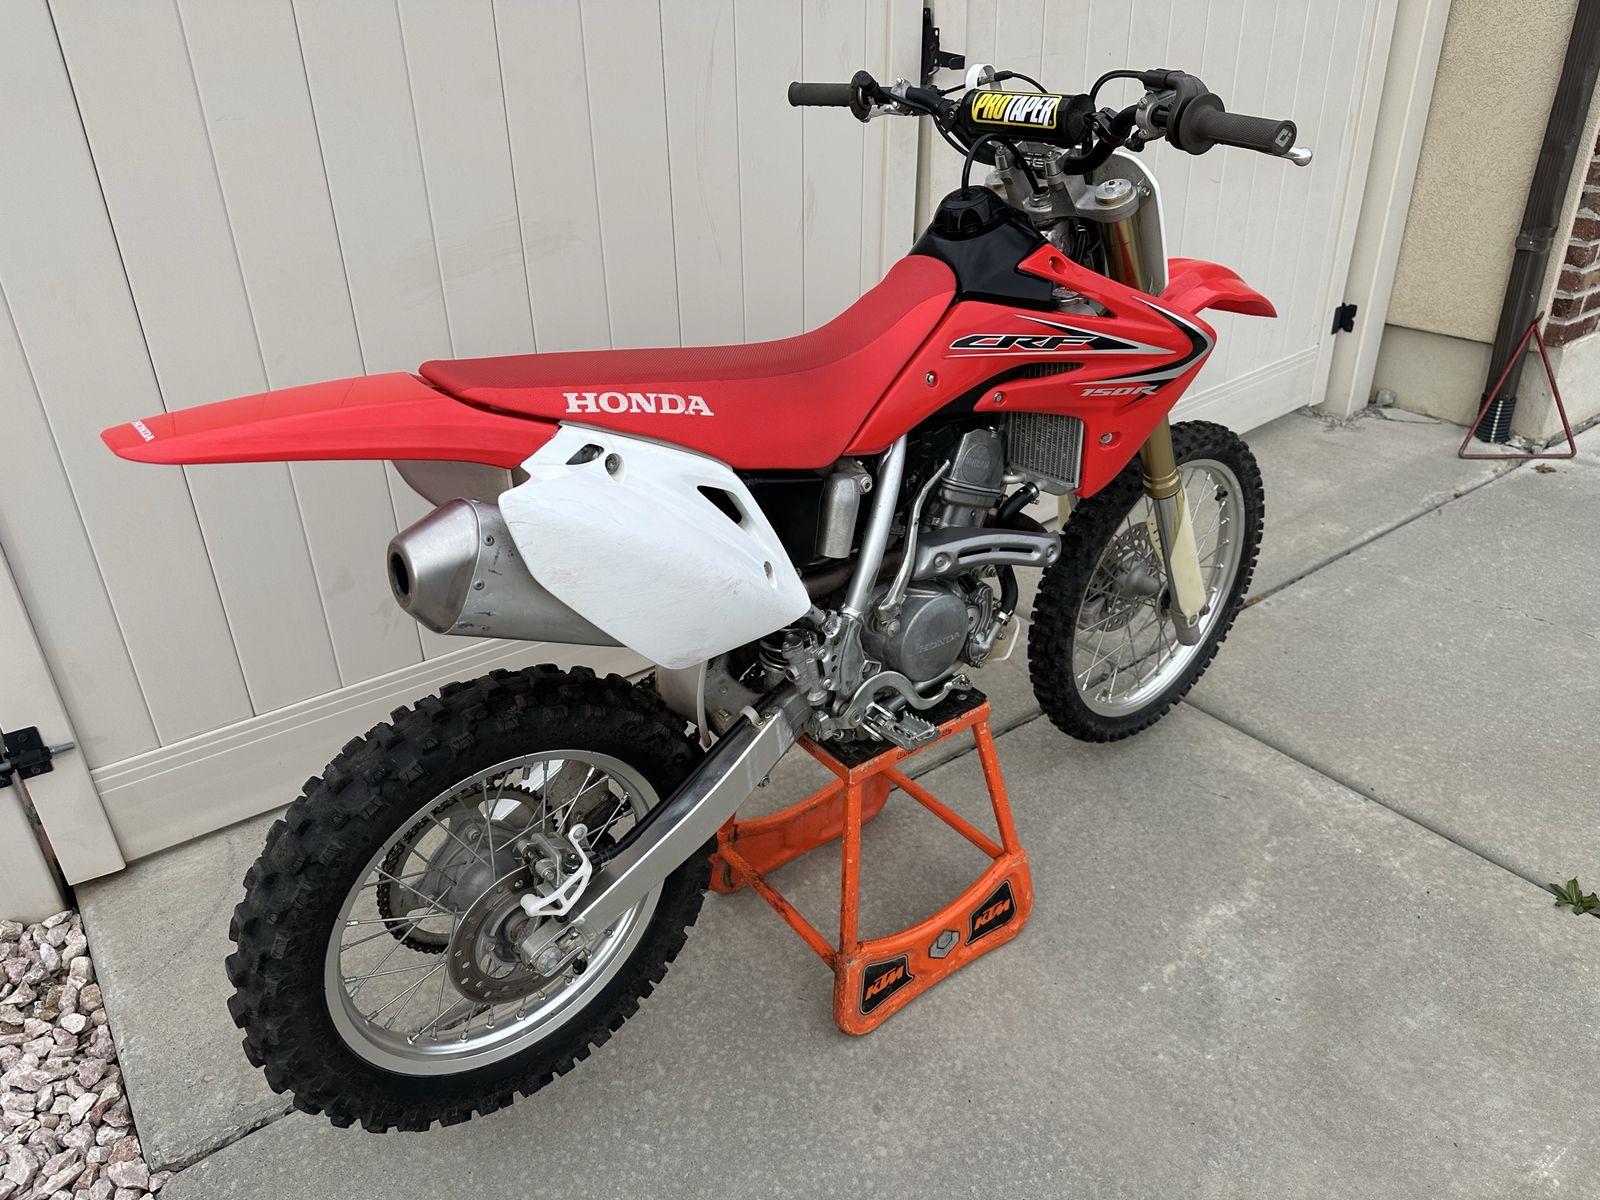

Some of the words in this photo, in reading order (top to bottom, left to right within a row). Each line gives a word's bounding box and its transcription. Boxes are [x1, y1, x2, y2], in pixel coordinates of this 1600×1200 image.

[950, 334, 1099, 350] CRF
[1080, 385, 1158, 397] 150R
[563, 392, 714, 416] HONDA
[974, 899, 1011, 930] KTM
[865, 966, 904, 1000] KTM
